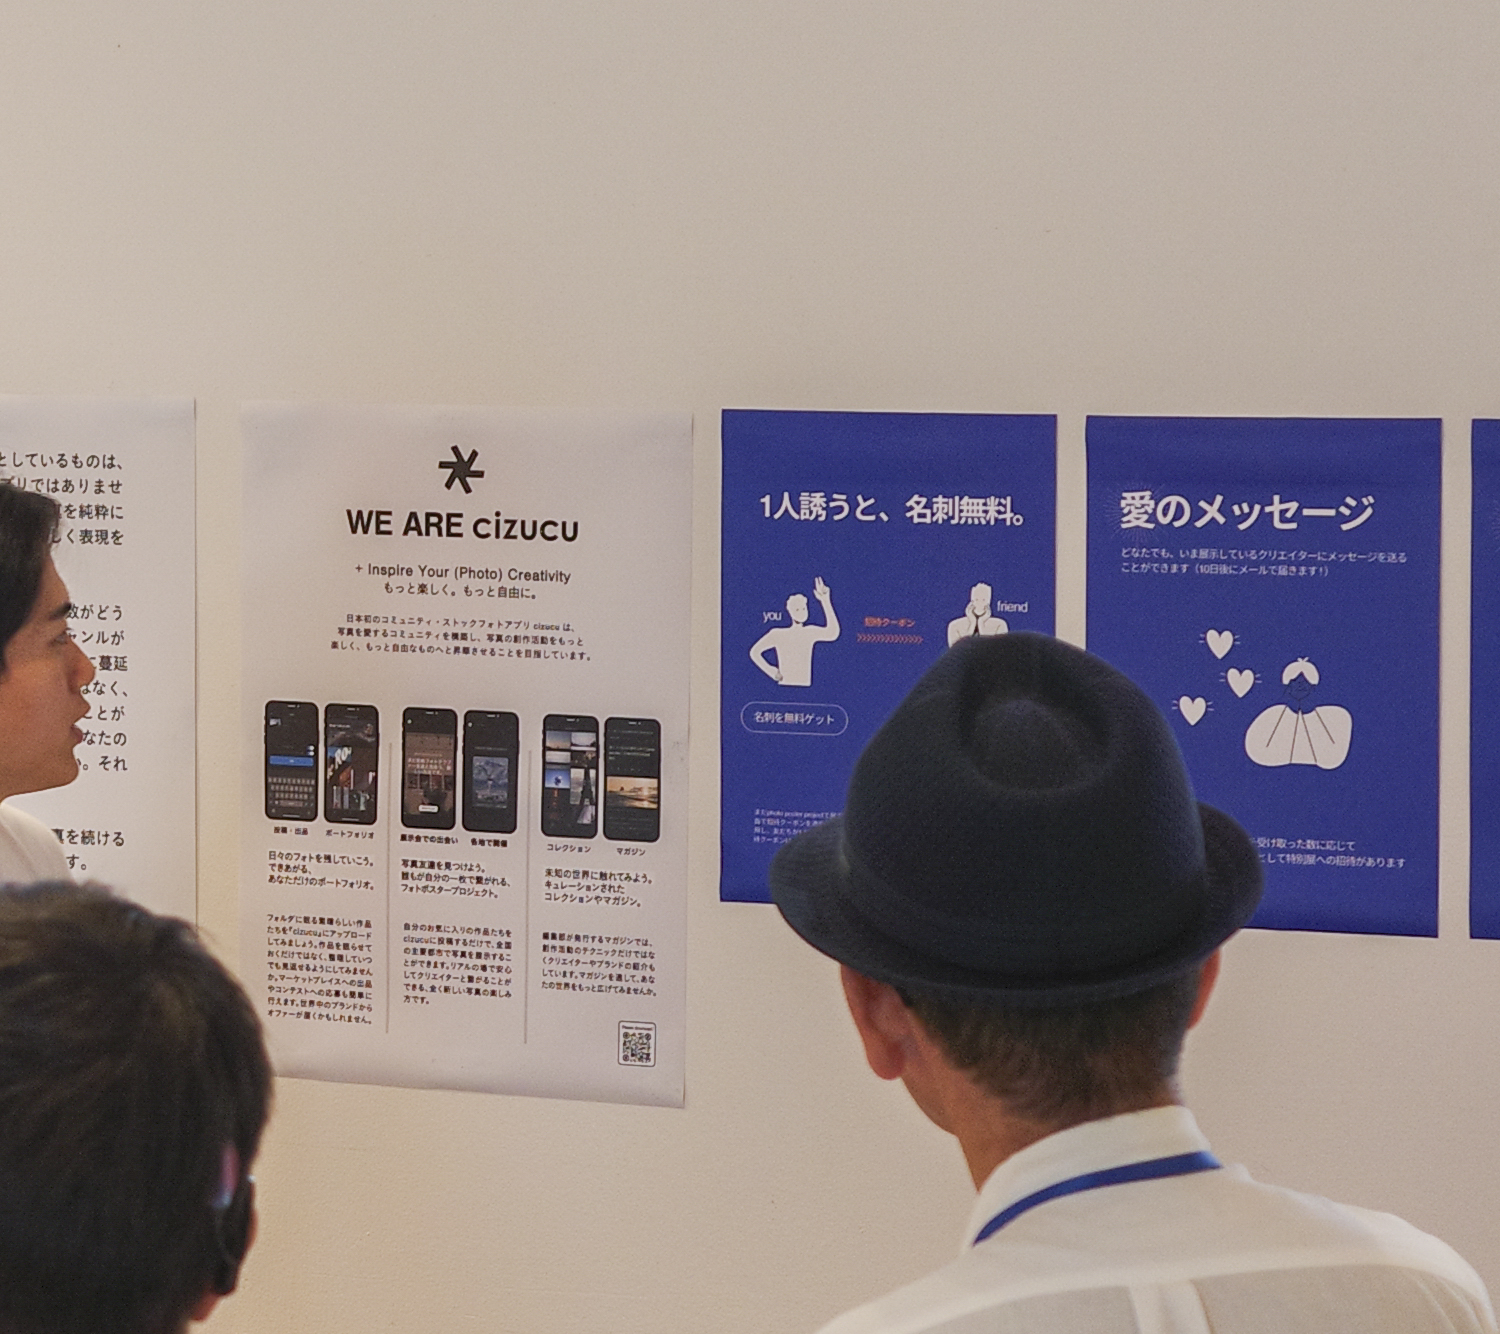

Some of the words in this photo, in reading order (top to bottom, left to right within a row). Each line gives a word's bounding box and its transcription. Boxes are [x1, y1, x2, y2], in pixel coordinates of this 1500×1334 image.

[1120, 489, 1375, 531] 愛のメッセージ
[346, 509, 393, 536] WE
[402, 511, 464, 538] ARE
[472, 510, 579, 543] cizucu
[368, 563, 414, 580] Inspire
[418, 565, 450, 579] Your
[454, 567, 503, 583] (Photo)
[507, 568, 571, 586] Creativity
[997, 599, 1029, 613] friend
[763, 611, 782, 622] you
[325, 829, 375, 839] ポートフォリオ
[547, 843, 592, 854] コレクション
[616, 847, 646, 856] マガジン
